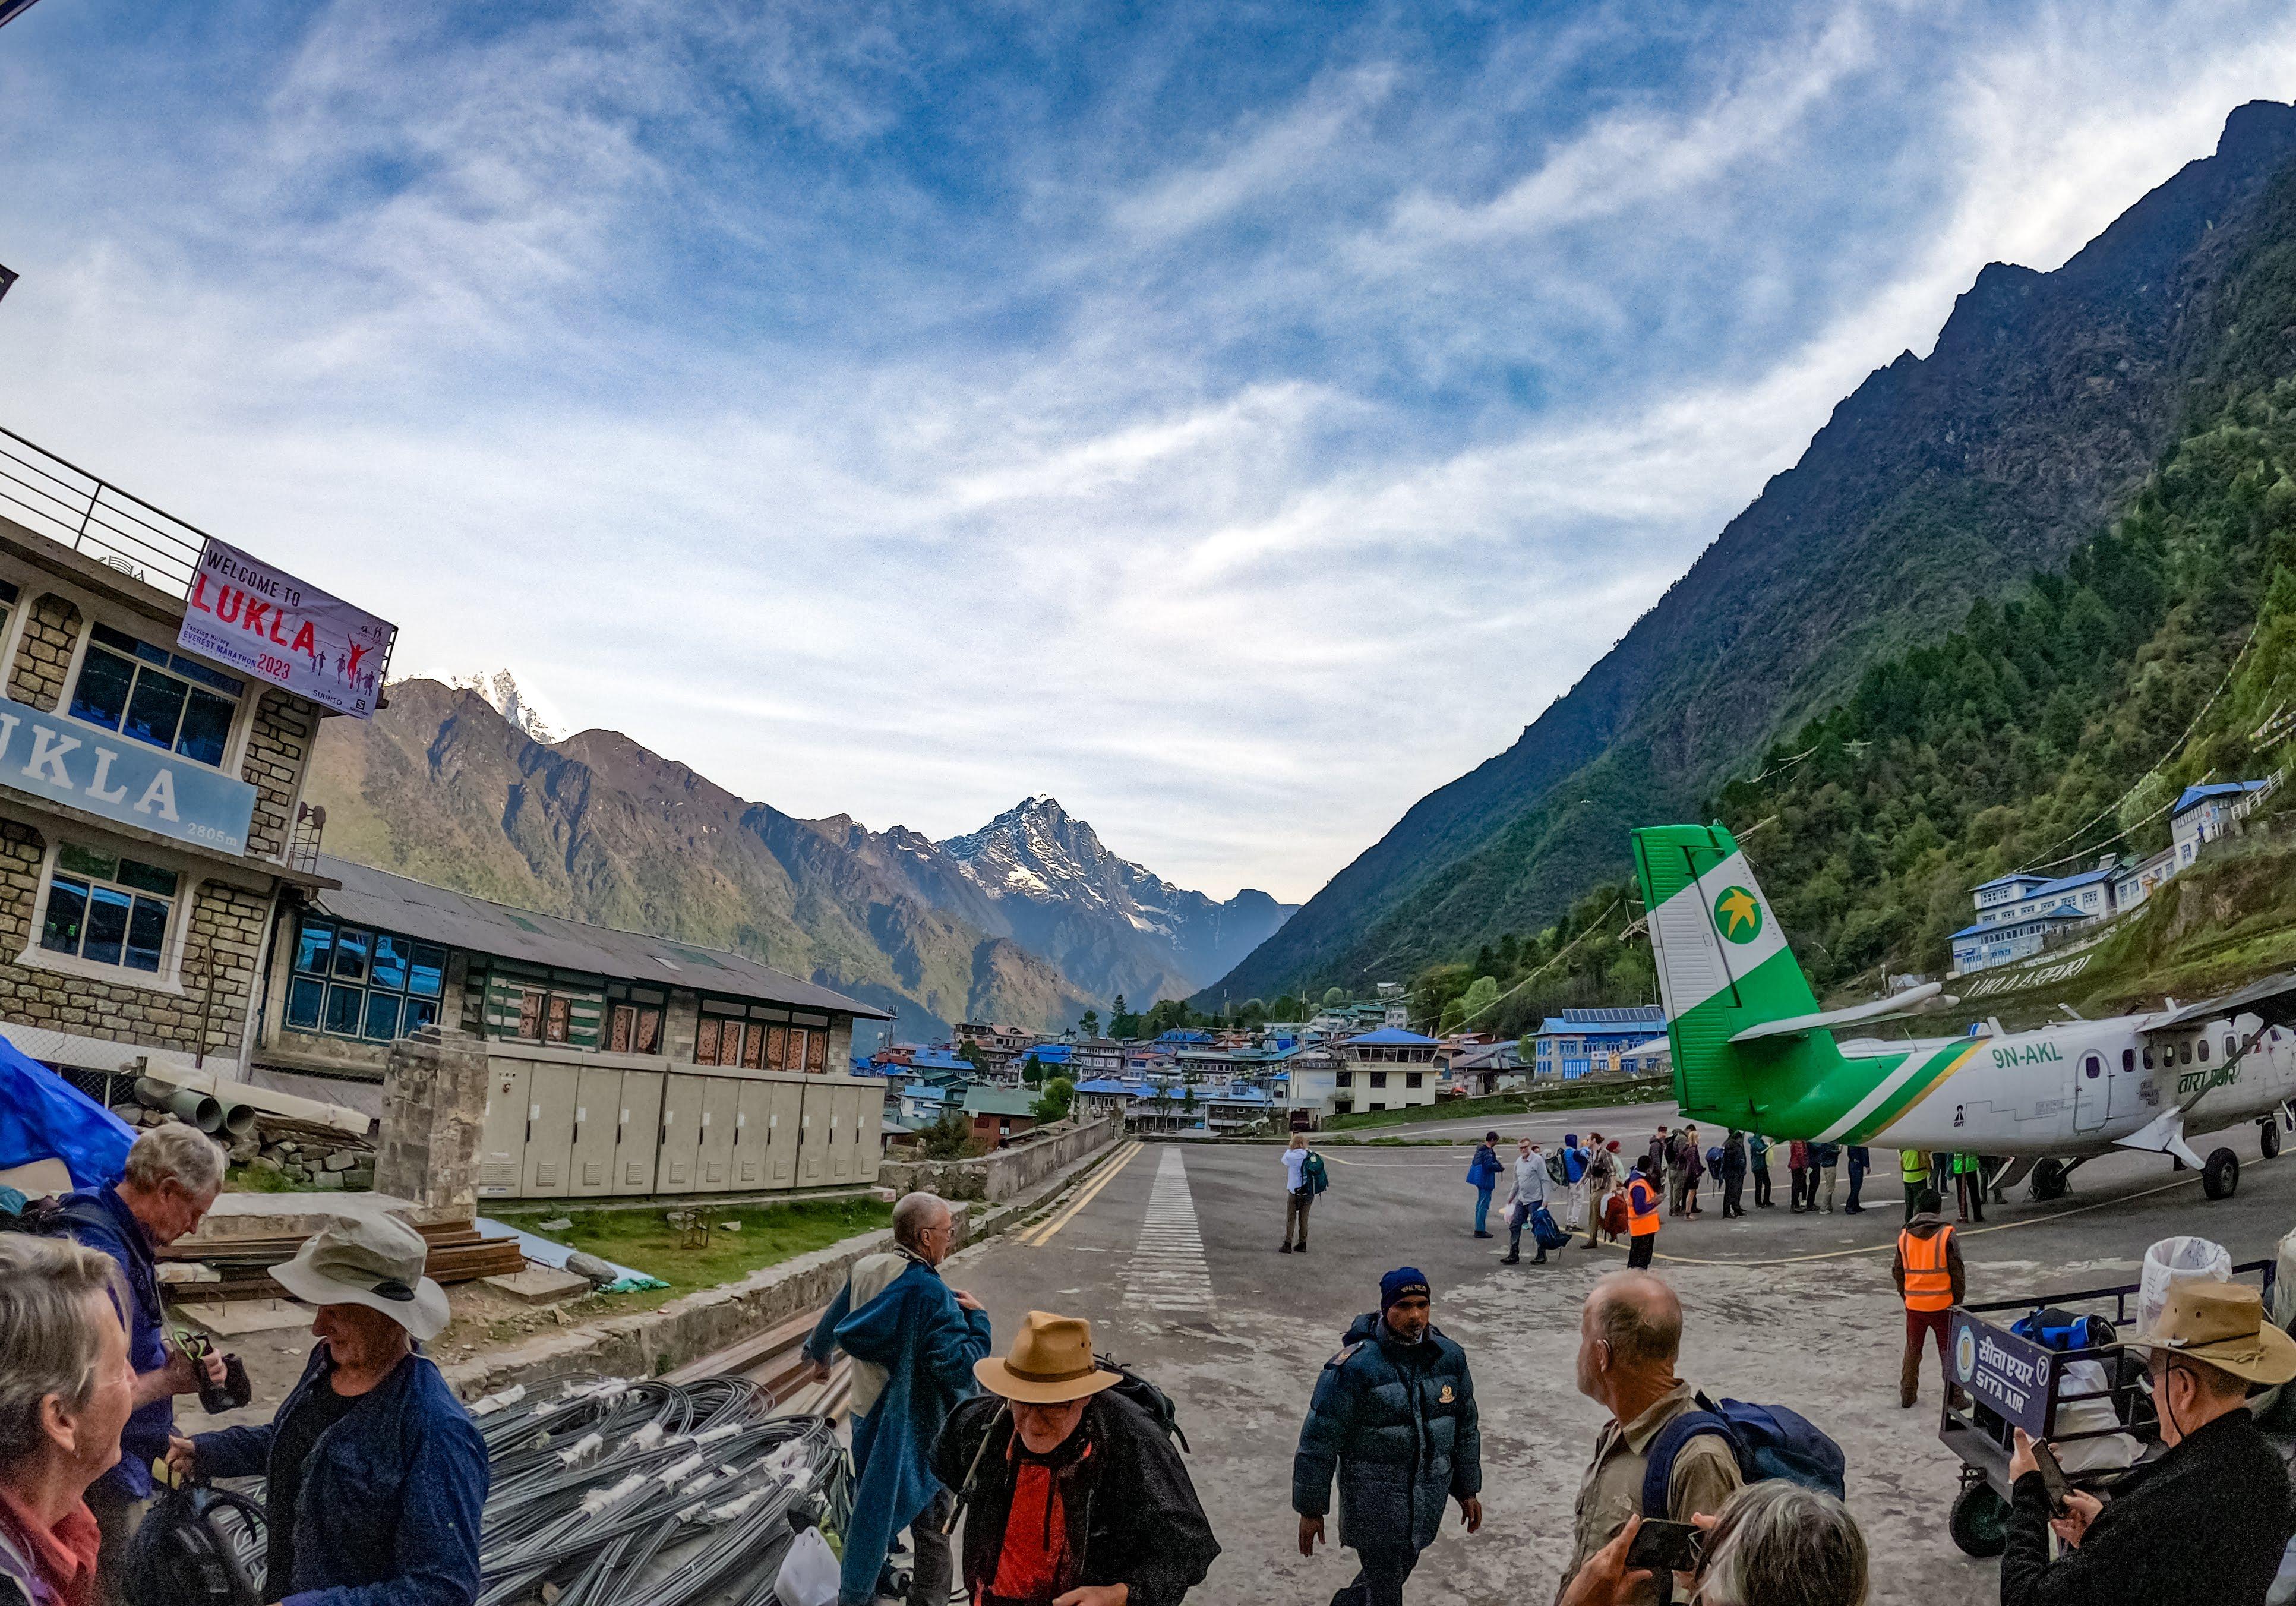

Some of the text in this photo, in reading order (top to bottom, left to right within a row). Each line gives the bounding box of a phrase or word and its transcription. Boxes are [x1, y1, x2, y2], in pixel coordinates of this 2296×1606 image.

[208, 550, 301, 607] WELCOME TO
[192, 572, 314, 657] LUKLA
[186, 624, 230, 646] Tenzing Hillary
[184, 631, 214, 649] EVEREST
[216, 645, 256, 667] MARATHON
[257, 654, 290, 679] 2023
[313, 690, 342, 705] SUUNTO
[187, 822, 238, 847] 2805m
[2013, 954, 2094, 990] AIRPORT
[1992, 1042, 2063, 1068] 9N-AKL
[1979, 1336, 2007, 1371] सीता
[2039, 1361, 2046, 1380] 7
[1976, 1370, 2025, 1414] SITA AIR
